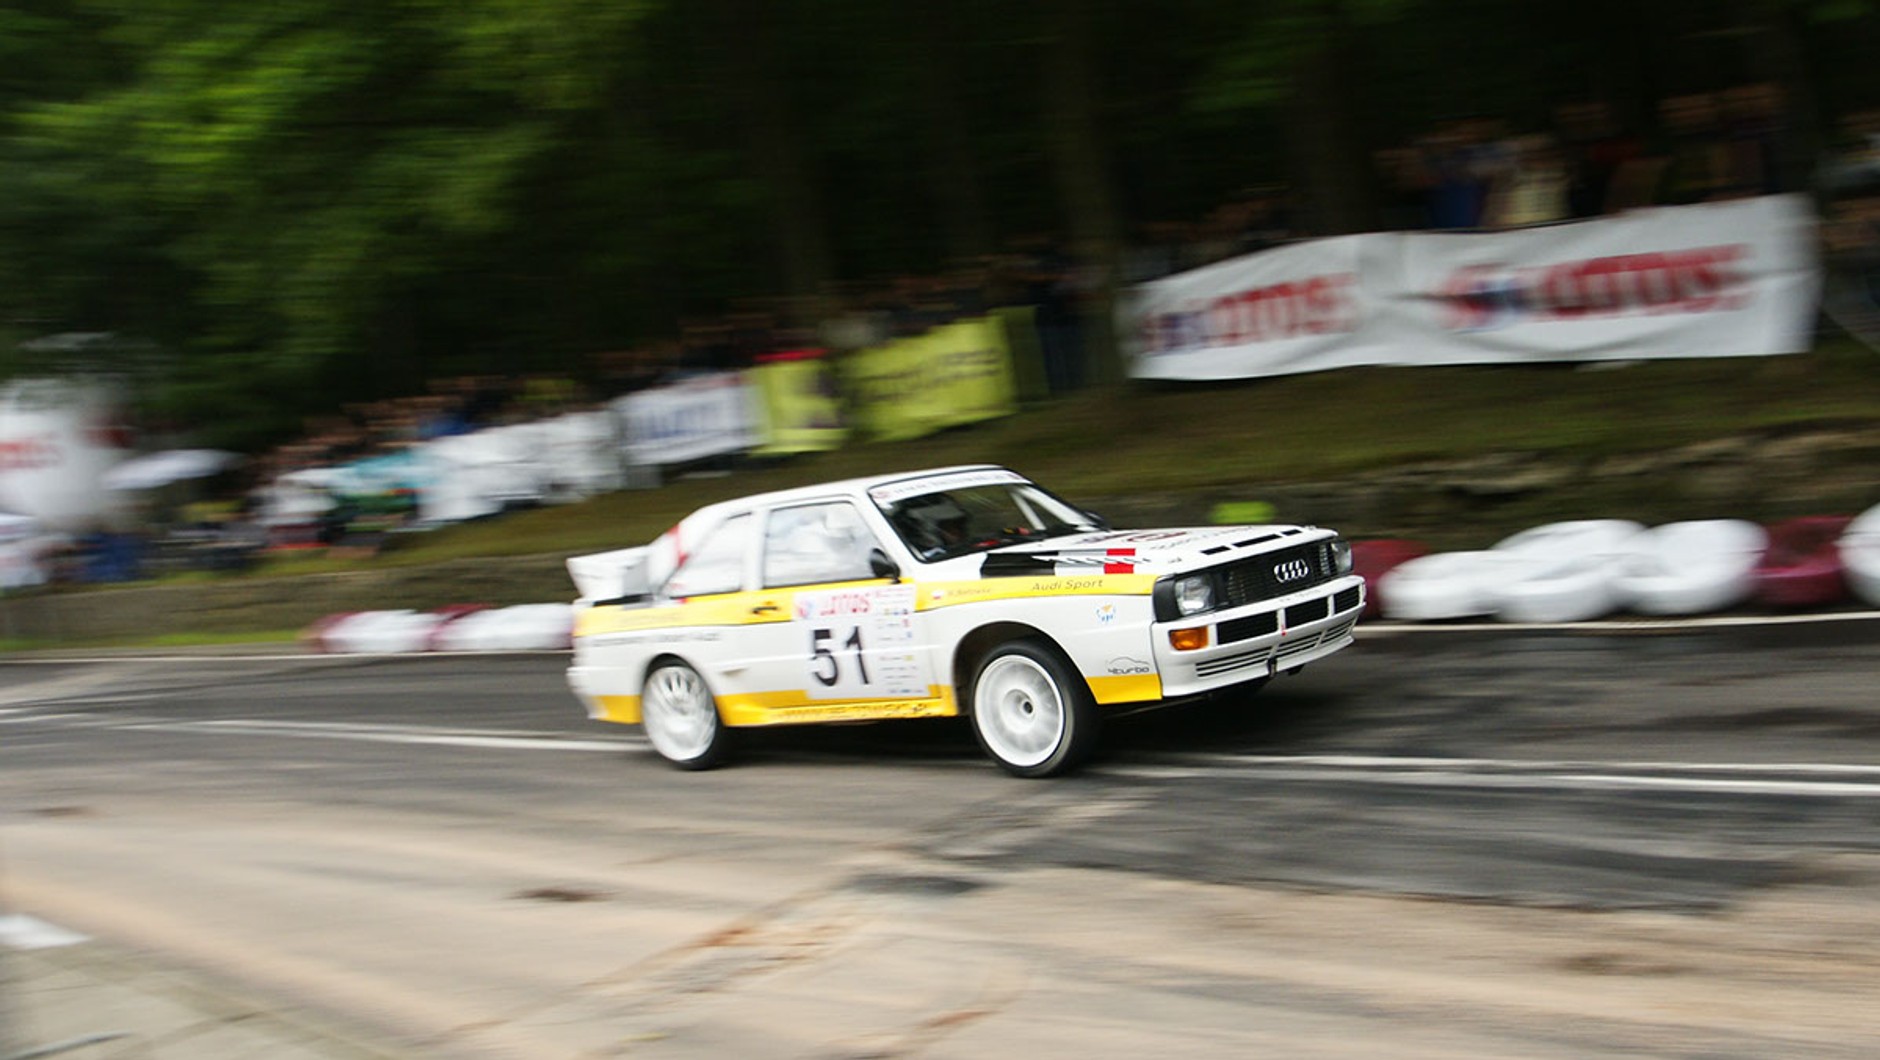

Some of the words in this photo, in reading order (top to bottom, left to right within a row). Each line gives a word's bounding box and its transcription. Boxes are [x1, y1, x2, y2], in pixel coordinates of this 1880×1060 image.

[1032, 581, 1062, 592] Audi
[1065, 579, 1104, 591] Sport
[810, 625, 871, 687] 51
